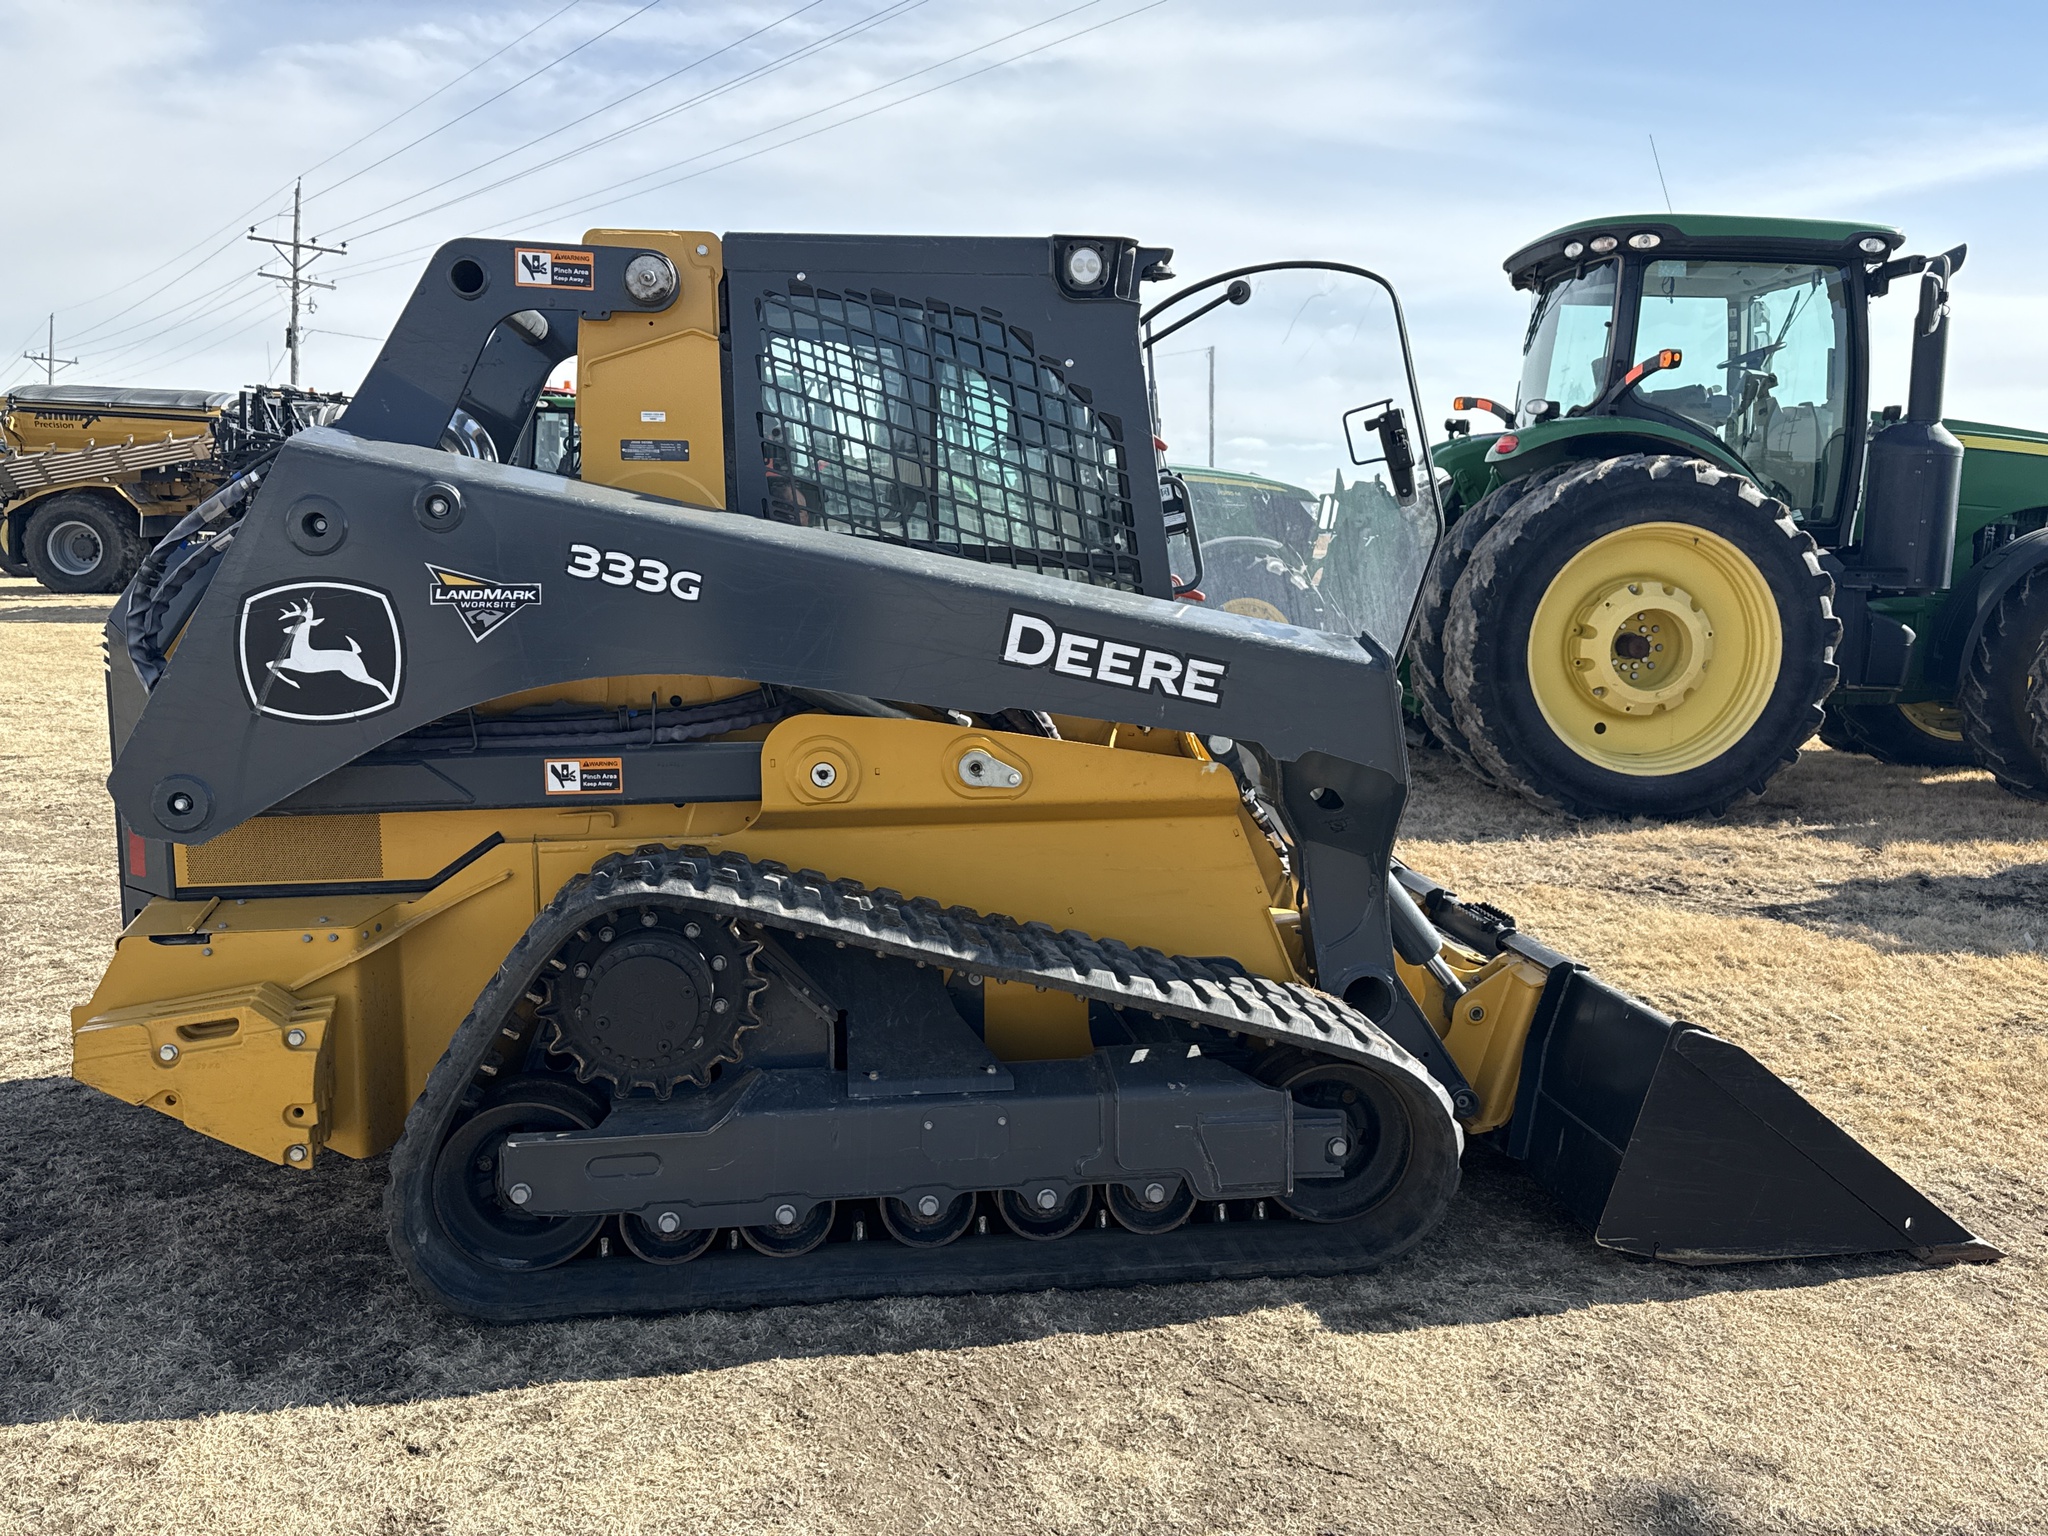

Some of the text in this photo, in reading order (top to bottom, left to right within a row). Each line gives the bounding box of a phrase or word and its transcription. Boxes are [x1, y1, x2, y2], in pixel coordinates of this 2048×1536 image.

[34, 421, 74, 429] Precision
[567, 543, 702, 601] 333G
[461, 601, 517, 609] WORKSITE
[1003, 613, 1226, 704] DEERE
